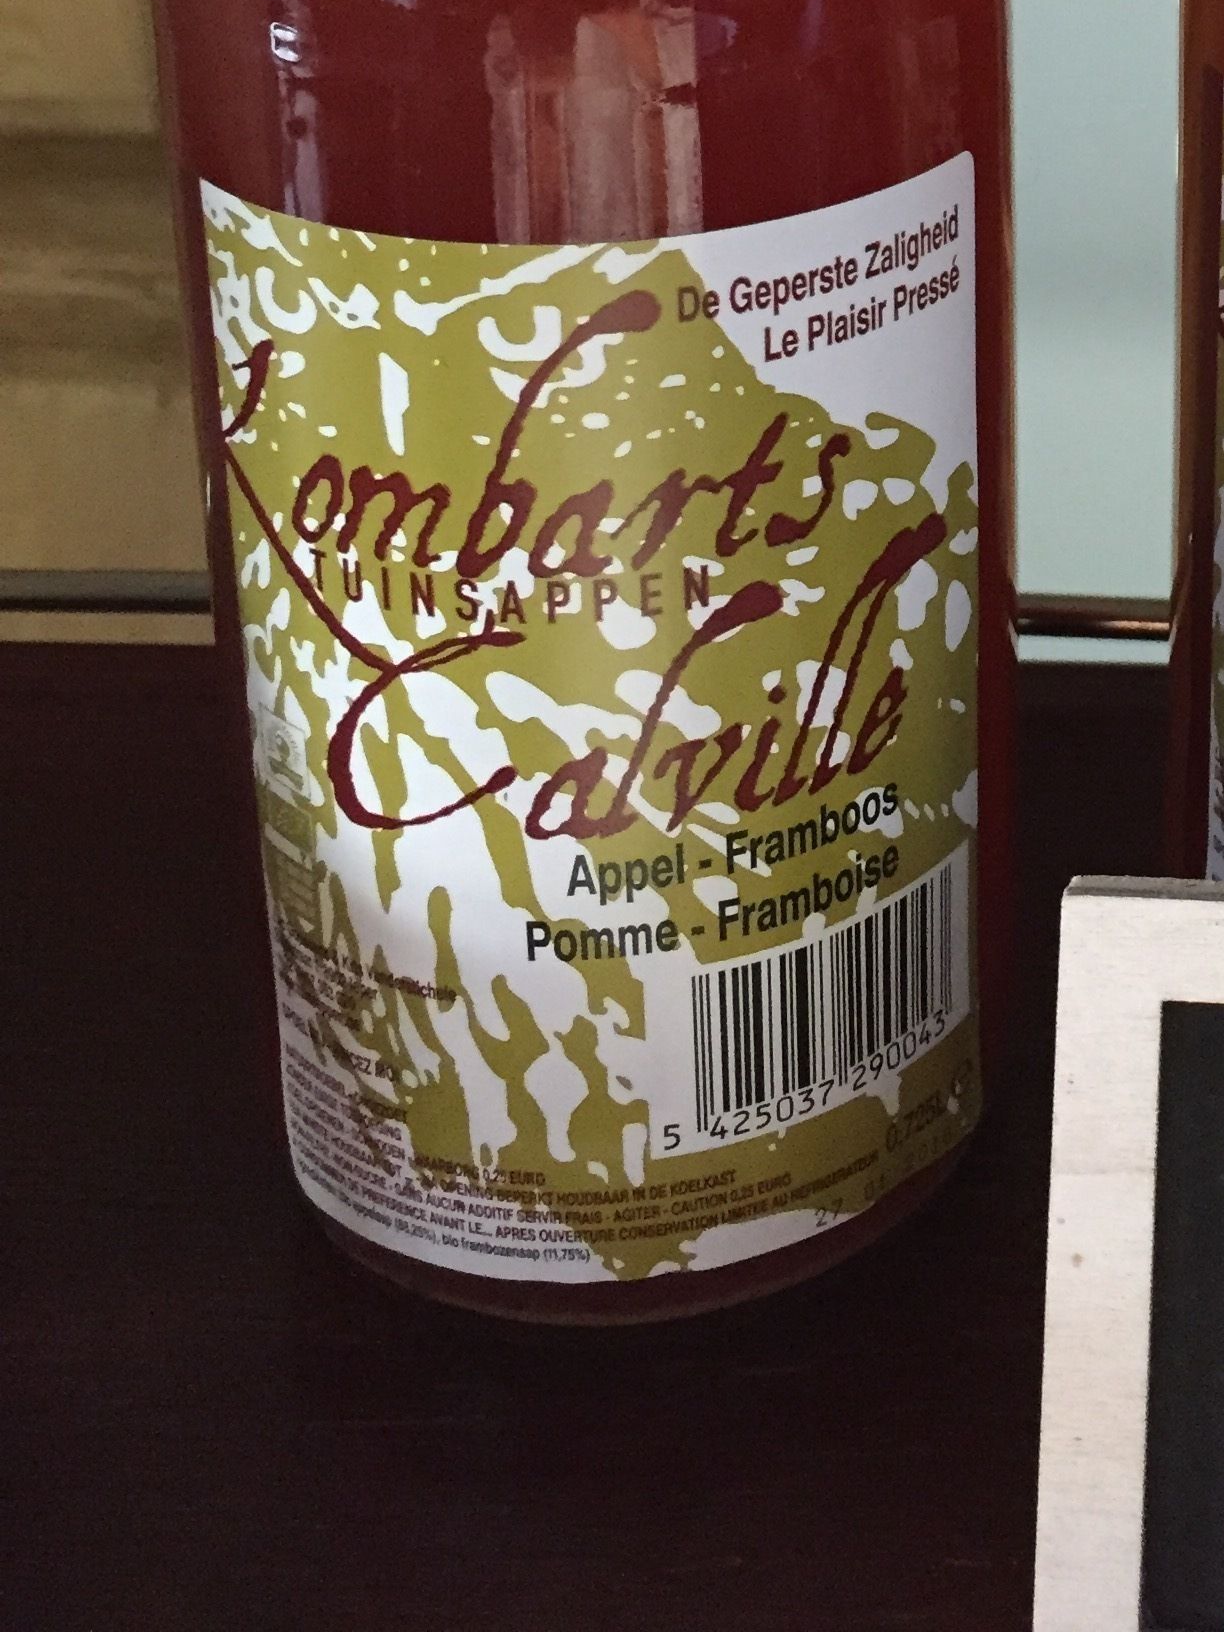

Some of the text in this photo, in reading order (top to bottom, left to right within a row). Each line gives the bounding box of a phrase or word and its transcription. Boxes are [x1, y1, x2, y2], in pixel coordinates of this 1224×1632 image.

[676, 203, 960, 324] De Geperste Zaligheid
[763, 254, 961, 363] Le Plaisir Pressé
[309, 547, 710, 625] TUINSAPPEN
[324, 514, 947, 841] Calville
[566, 843, 686, 907] Appel
[725, 780, 899, 876] Framboos
[525, 918, 681, 963] Pomme
[717, 843, 900, 942] Framboise
[662, 1009, 946, 1152] 5 425037 290043
[467, 1202, 514, 1222] ADDITIF
[516, 1209, 563, 1224] SERVIR
[613, 1204, 661, 1223] AGITER
[670, 1192, 728, 1216] CAUTION
[757, 1171, 793, 1193] EURO
[495, 1224, 537, 1243] APRES
[538, 1226, 616, 1244] OUVERTURE
[618, 1212, 719, 1240] CONSERVATION
[508, 1170, 546, 1187] EURO
[556, 1189, 631, 1207] HOUDBAAR
[631, 1186, 646, 1203] IN
[650, 1182, 668, 1200] DE
[670, 1168, 737, 1198] KOELKAST
